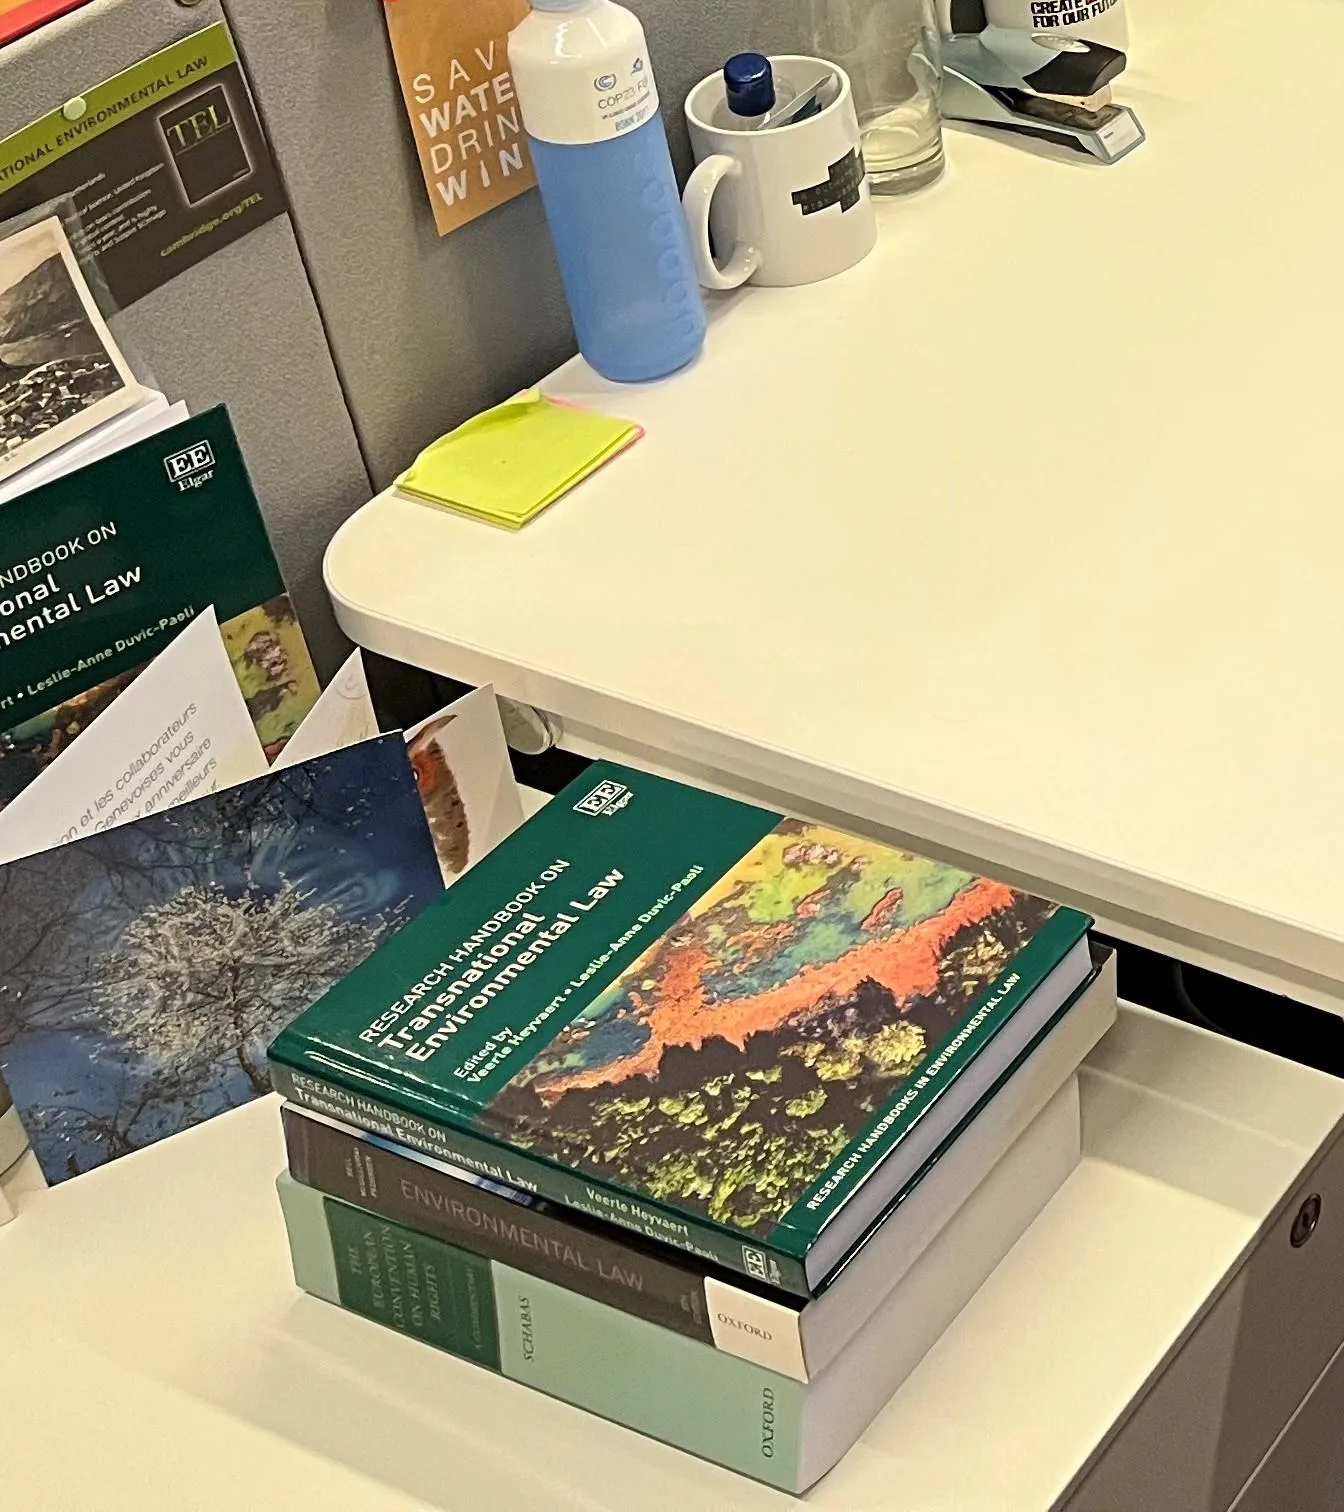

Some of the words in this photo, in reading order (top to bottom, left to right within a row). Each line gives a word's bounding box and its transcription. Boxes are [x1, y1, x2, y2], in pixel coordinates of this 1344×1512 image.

[1032, 14, 1060, 28] FOR
[1062, 7, 1090, 26] OUR
[56, 74, 176, 146] ENVIRONMENTAL
[177, 55, 209, 80] LAW
[412, 40, 494, 104] SAV
[418, 71, 515, 139] WATE
[598, 87, 636, 110] COP23
[166, 105, 231, 147] TEL
[429, 106, 521, 175] DRIN
[435, 142, 524, 207] WIN
[168, 445, 210, 478] EE
[178, 469, 213, 491] Elgar
[87, 521, 117, 546] ON
[85, 566, 141, 605] Law
[27, 648, 113, 696] Leslie-Anne
[115, 605, 195, 652] Duvic-Paoli
[80, 808, 94, 828] et
[94, 790, 115, 813] les
[115, 702, 198, 790] collaborateurs
[94, 762, 165, 833] Genevoises
[165, 731, 195, 764] vous
[144, 738, 212, 814] anniversaire
[577, 782, 622, 813] EE
[359, 961, 455, 1043] RESEARCH
[448, 881, 546, 963] HANDBOOK
[539, 858, 572, 882] ON
[378, 912, 546, 1050] Transnational
[405, 913, 580, 1063] Environmental
[569, 868, 625, 912] Law
[466, 1046, 513, 1084] Veerle
[512, 994, 567, 1047] Heyvaert
[570, 923, 643, 988] Leslie-Anne
[637, 864, 705, 925] Duvic-Paoli
[453, 1041, 497, 1080] Edited
[492, 1026, 514, 1044] by
[291, 1072, 355, 1108] RESEARCH
[356, 1096, 426, 1136] HANDBOOK
[427, 1128, 447, 1144] ON
[806, 1152, 863, 1212] RESEARCH
[857, 1088, 919, 1155] HANDBOOKS
[915, 1074, 931, 1091] IN
[928, 996, 1002, 1078] ENVIRONMENTAL
[997, 972, 1021, 997] LAW
[294, 1087, 393, 1137] Transnational
[398, 1128, 503, 1179] Environmental
[505, 1169, 539, 1193] Law
[400, 1178, 592, 1271] ENVIRONMENTAL
[597, 1262, 645, 1292] LAW
[564, 1194, 643, 1234] Leslie-Anne
[585, 1186, 629, 1214] Veerle
[630, 1204, 690, 1237] Heyvaert
[381, 1223, 406, 1329] CONVENTION
[400, 1240, 420, 1301] HUMAN
[425, 1263, 441, 1322] RIGHTS
[411, 1305, 424, 1328] ON
[519, 1295, 535, 1363] SCHABAS
[717, 1311, 773, 1342] OXFORD
[761, 1387, 775, 1459] OXFORD
